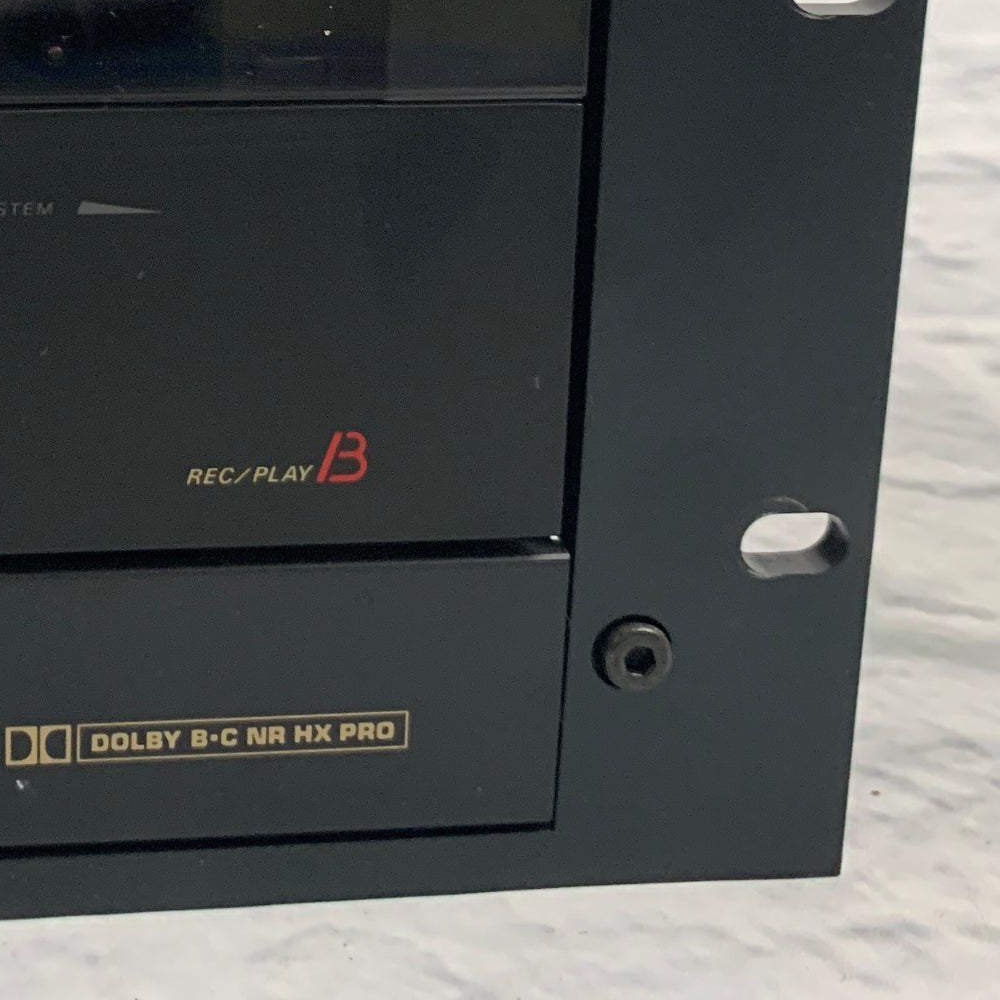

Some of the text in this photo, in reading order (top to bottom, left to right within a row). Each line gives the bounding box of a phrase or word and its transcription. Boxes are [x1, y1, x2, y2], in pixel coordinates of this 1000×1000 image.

[186, 431, 368, 485] REC/PLAY B
[91, 730, 182, 752] DOLBY
[246, 725, 286, 745] NR
[294, 723, 333, 743] HX
[339, 721, 395, 741] PRO
